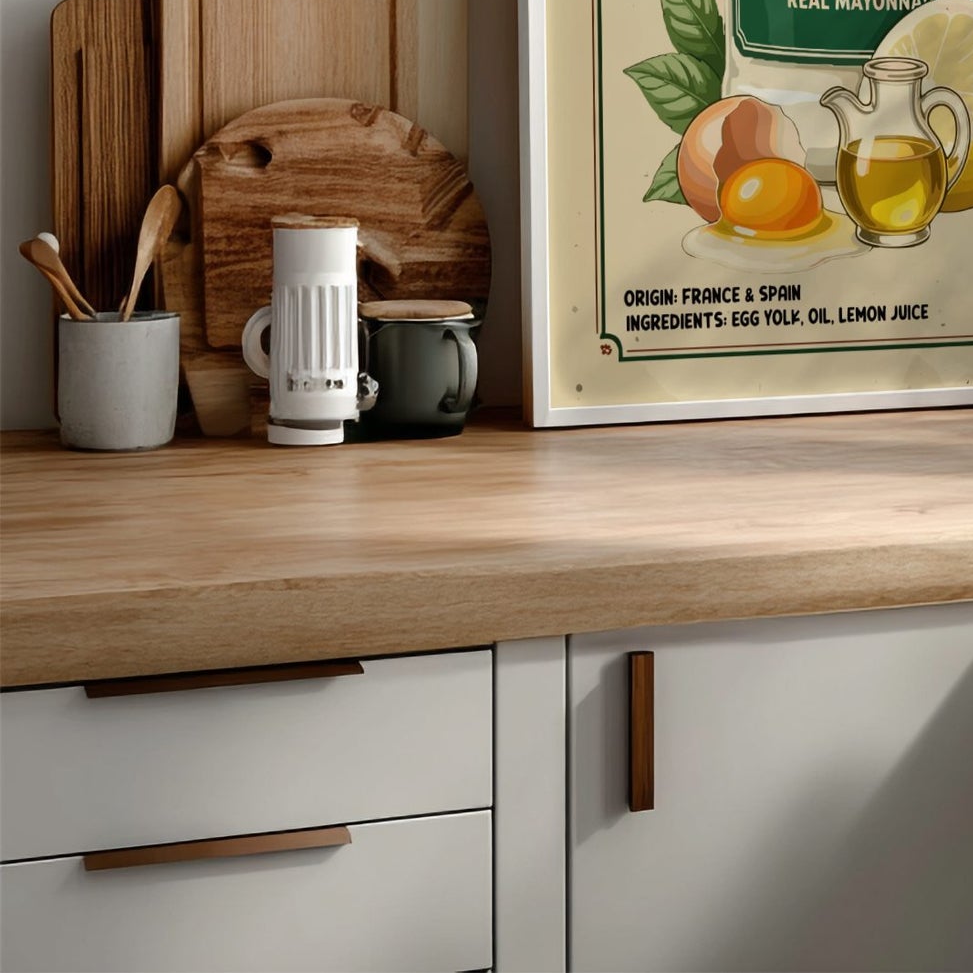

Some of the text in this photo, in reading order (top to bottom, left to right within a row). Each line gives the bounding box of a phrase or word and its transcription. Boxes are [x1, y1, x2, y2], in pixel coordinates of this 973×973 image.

[624, 284, 801, 307] ORIGIN: FRANCE & SPAIN
[626, 304, 929, 332] INGREDIENTS: EGG YOLK, OIL, LEMON JUICE
